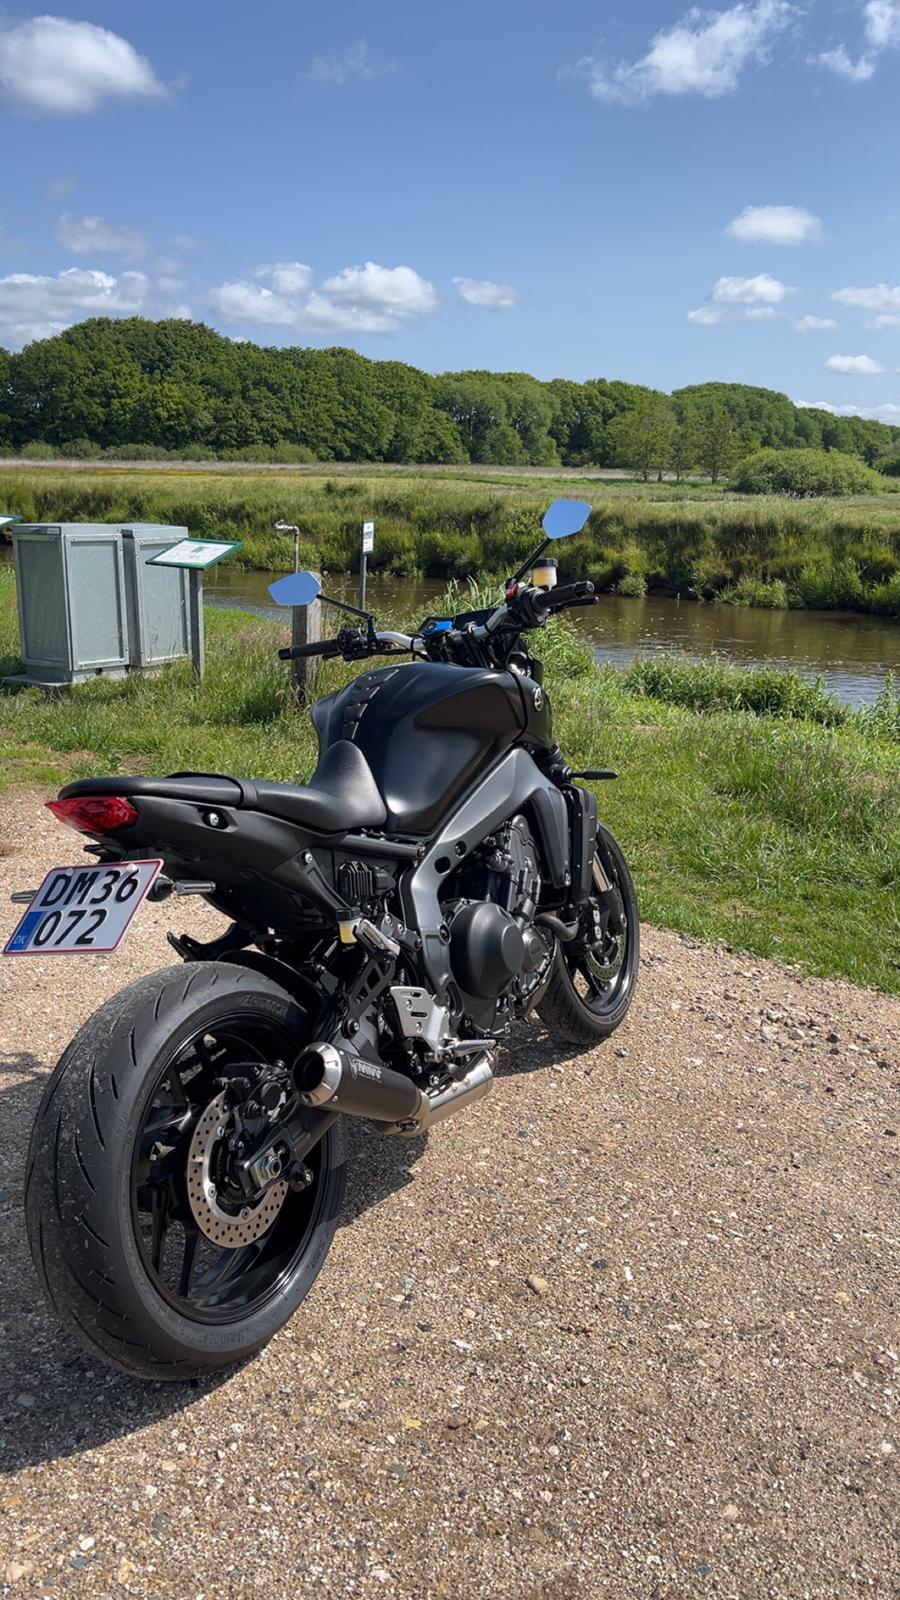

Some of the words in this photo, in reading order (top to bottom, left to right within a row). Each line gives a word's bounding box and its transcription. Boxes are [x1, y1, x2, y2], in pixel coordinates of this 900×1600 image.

[40, 869, 140, 907] DM36
[13, 935, 27, 944] DK
[33, 909, 108, 946] 072
